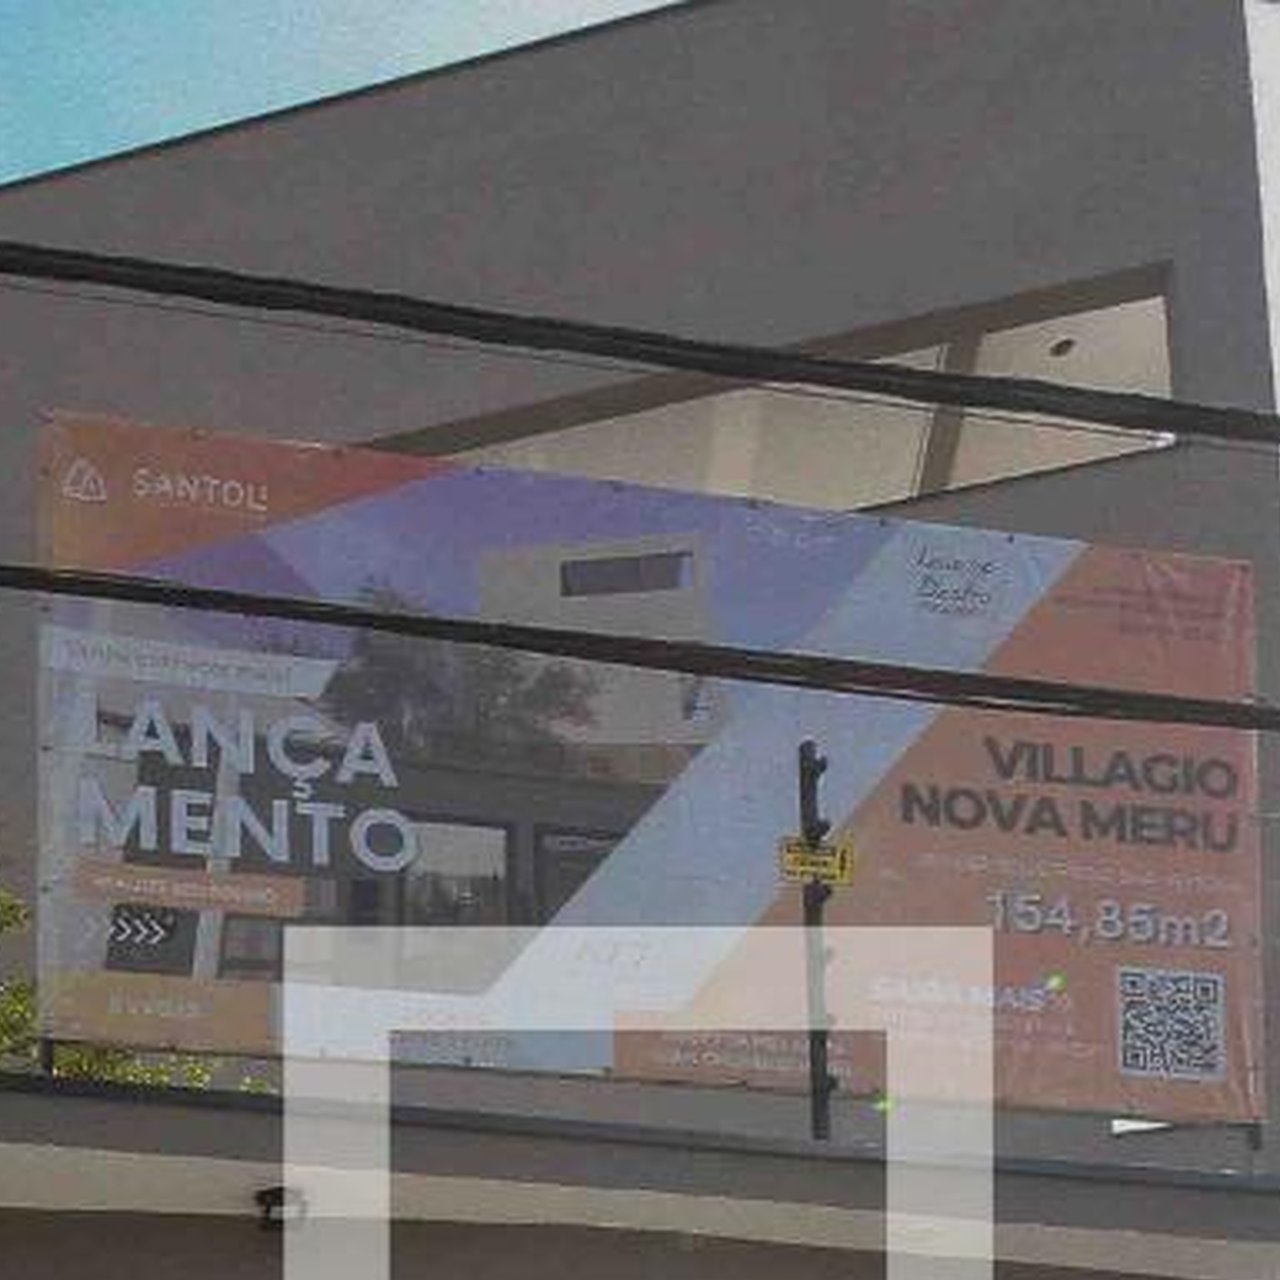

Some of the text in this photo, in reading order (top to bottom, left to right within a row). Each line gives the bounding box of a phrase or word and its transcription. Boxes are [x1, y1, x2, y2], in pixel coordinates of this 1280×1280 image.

[75, 692, 398, 799] LANÇA
[983, 736, 1239, 799] VILLAGIO
[76, 774, 417, 872] MENTO
[899, 781, 1238, 854] NOVA MERU
